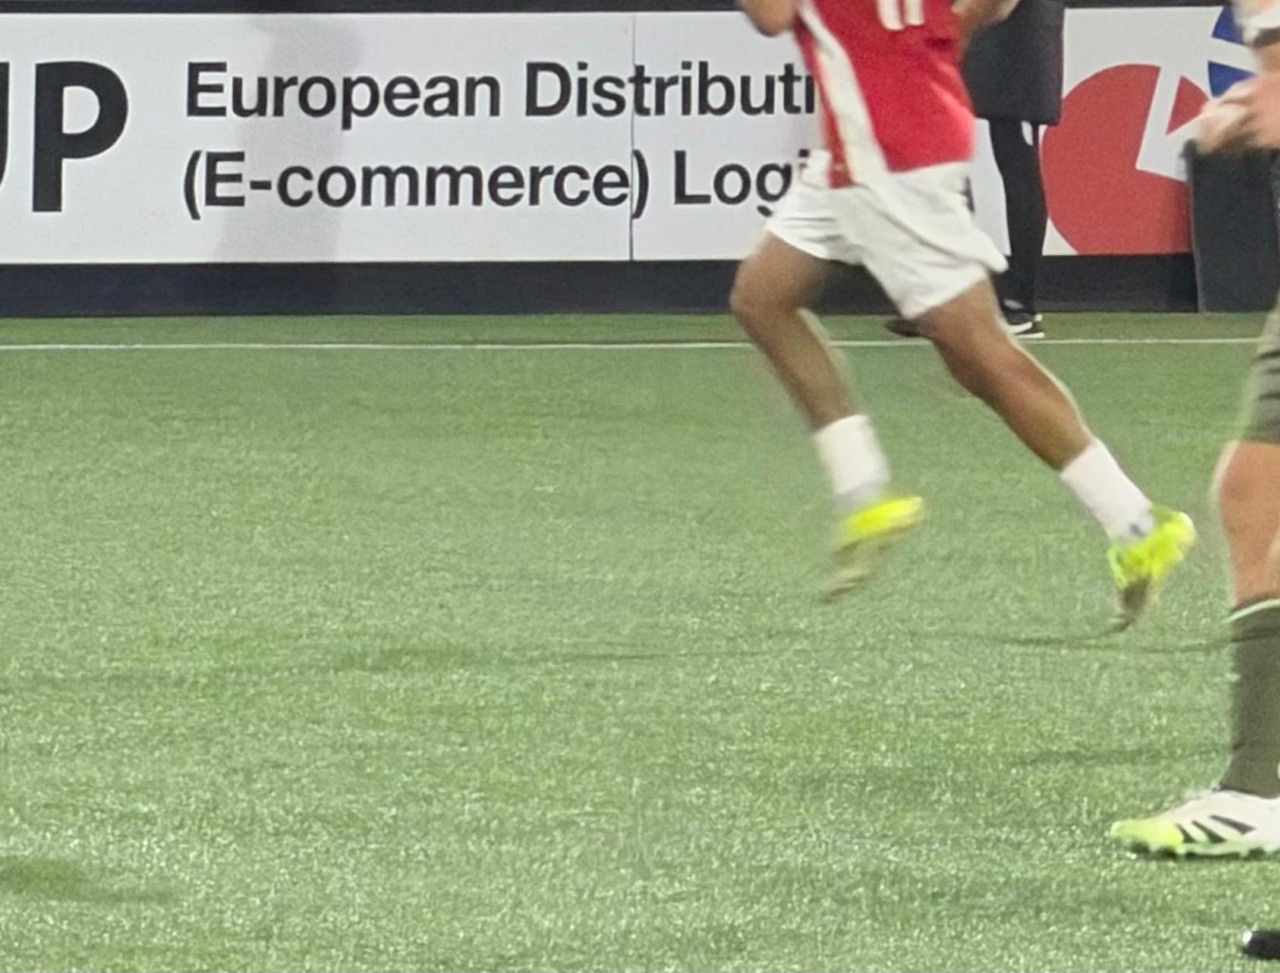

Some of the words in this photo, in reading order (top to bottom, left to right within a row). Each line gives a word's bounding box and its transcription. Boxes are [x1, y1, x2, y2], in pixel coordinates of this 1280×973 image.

[185, 61, 502, 130] European
[0, 60, 129, 212] P
[183, 148, 651, 220] (E-commerce)
